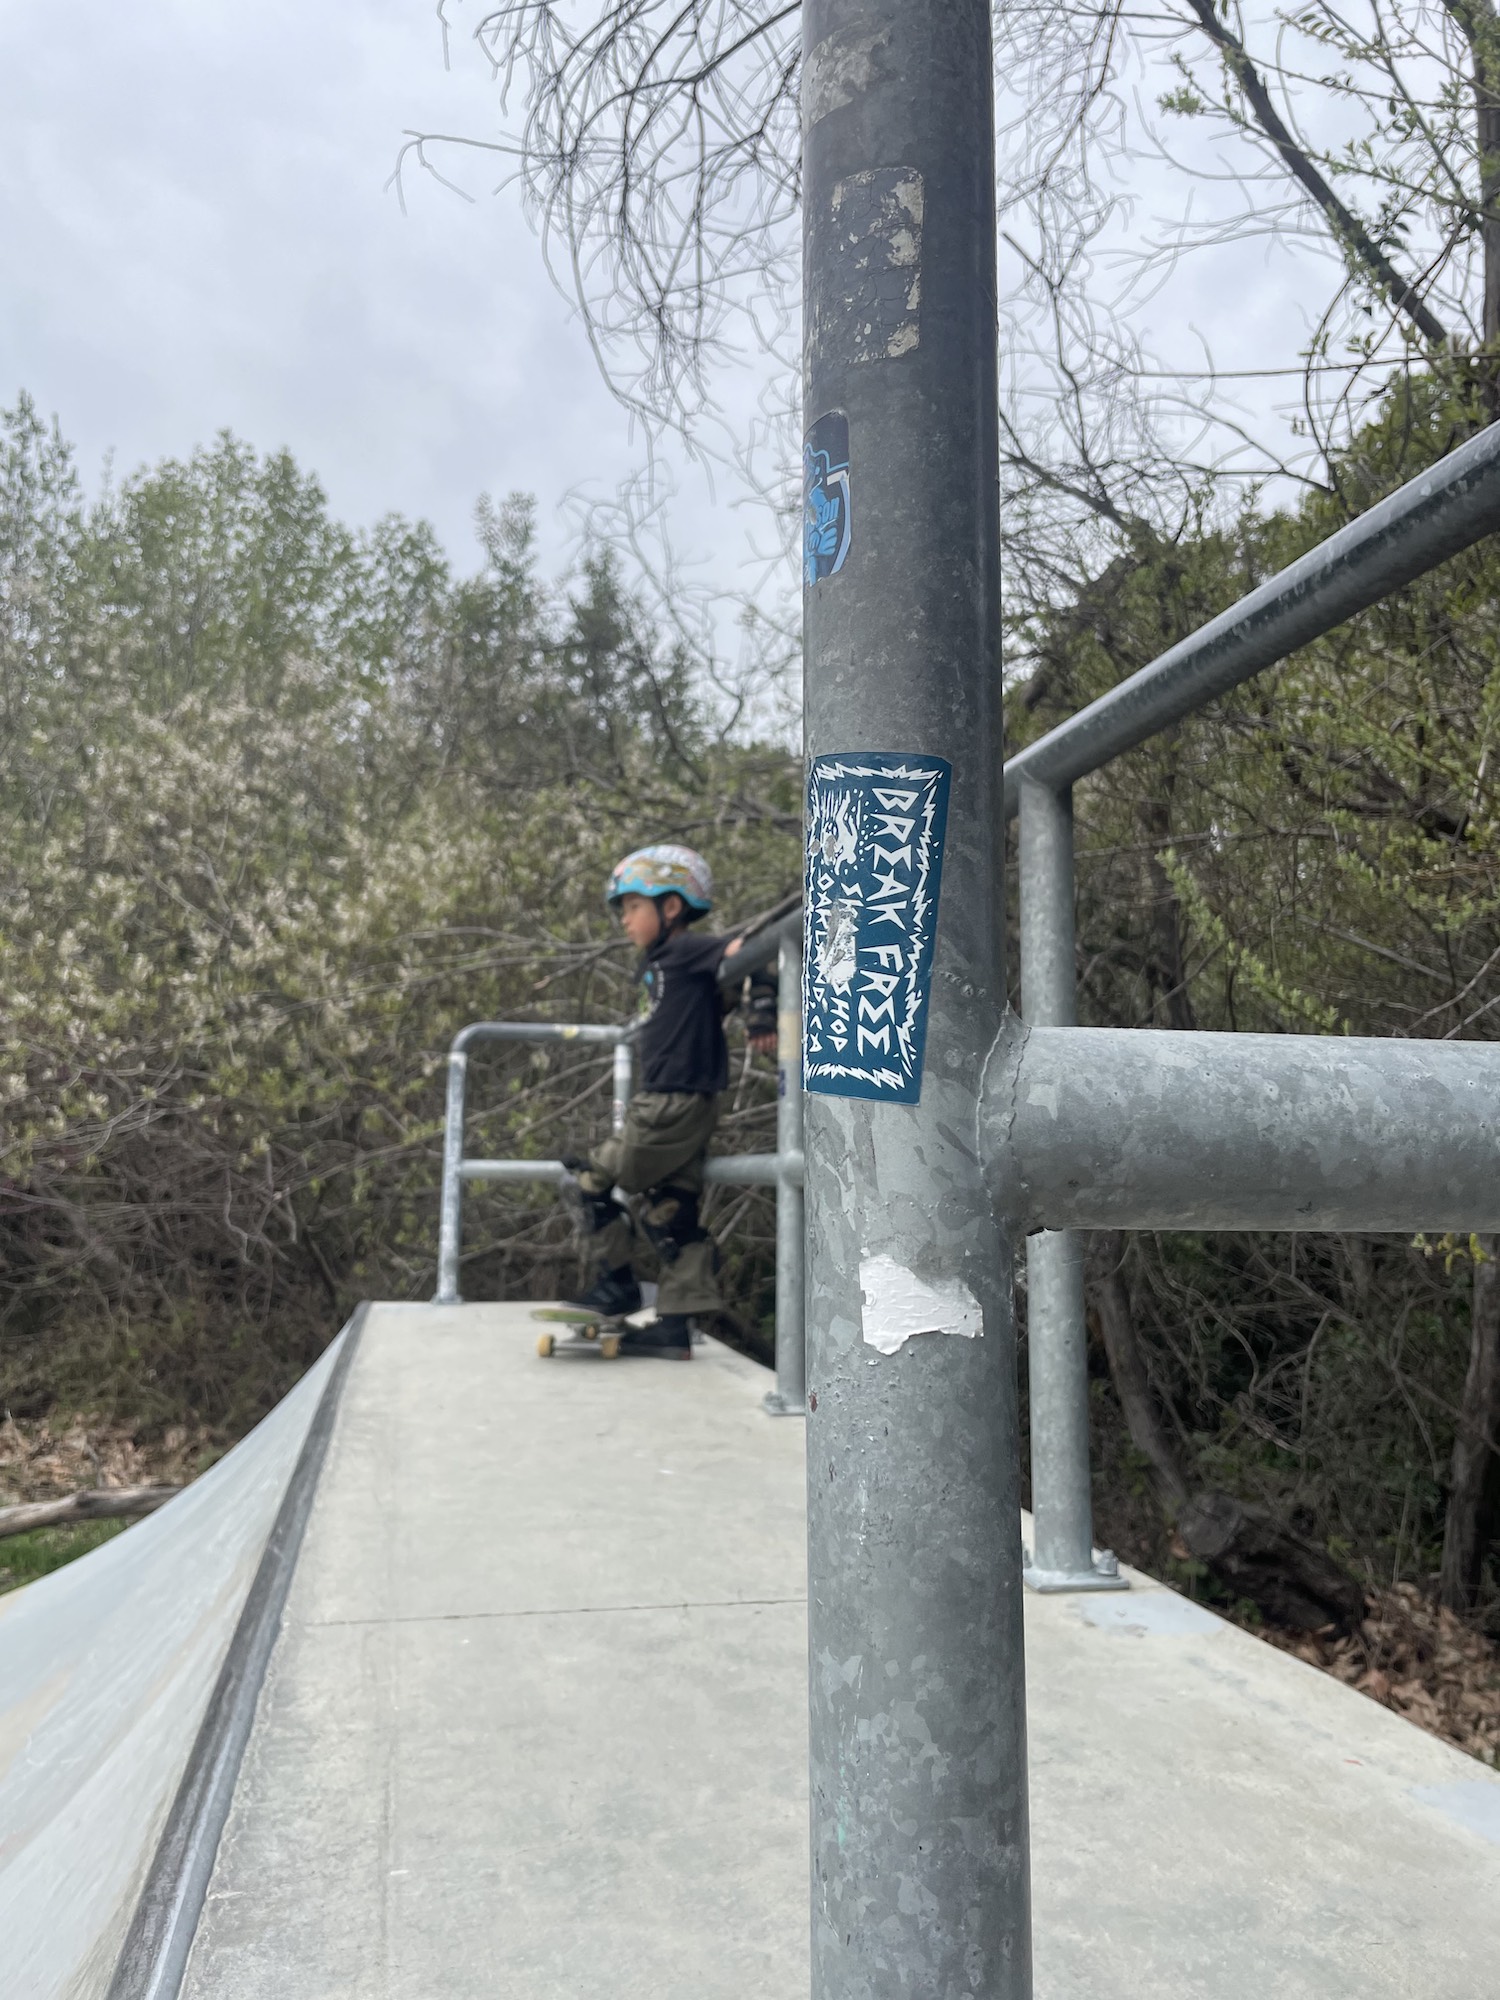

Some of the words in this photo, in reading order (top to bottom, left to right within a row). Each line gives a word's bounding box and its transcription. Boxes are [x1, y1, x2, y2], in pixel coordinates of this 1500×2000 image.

[866, 788, 919, 931] BREAK
[809, 1015, 823, 1052] CA
[826, 978, 852, 1053] SHOP
[856, 944, 904, 1057] FREE
